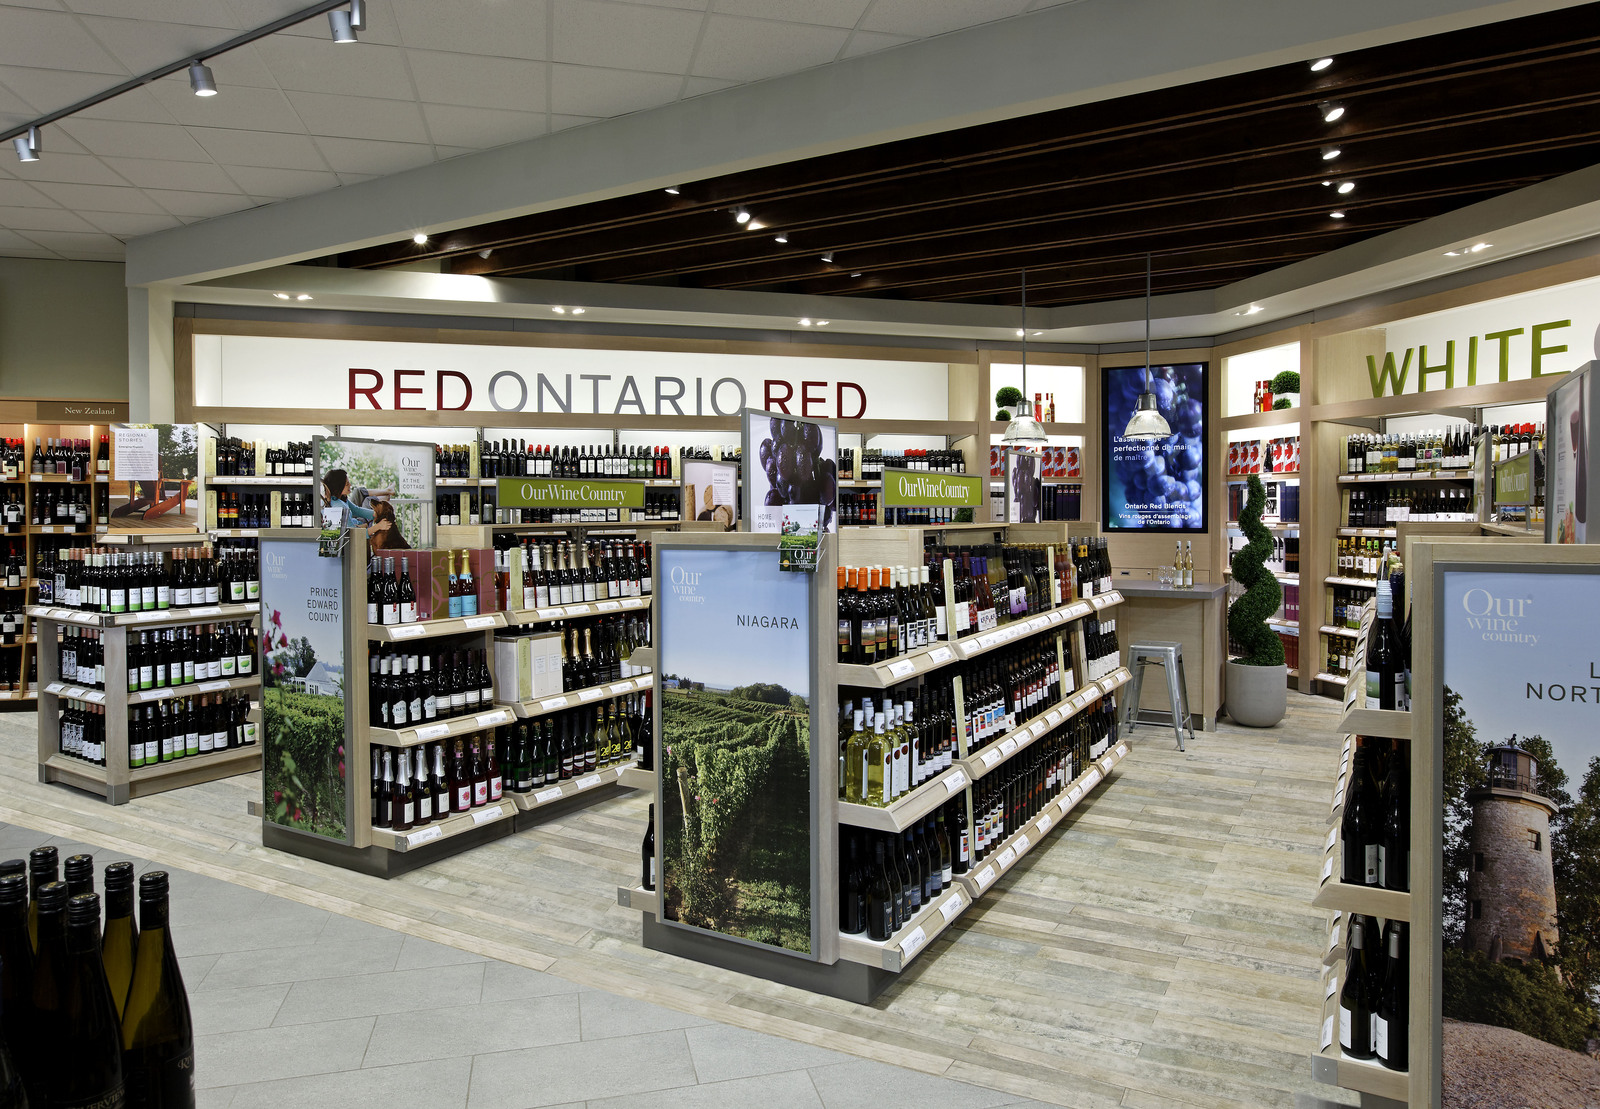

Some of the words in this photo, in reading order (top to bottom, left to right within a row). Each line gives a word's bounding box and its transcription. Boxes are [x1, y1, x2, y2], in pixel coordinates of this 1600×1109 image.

[1366, 319, 1571, 398] WHITE
[349, 368, 473, 411] RED
[488, 370, 747, 417] ONTARIO
[764, 379, 867, 419] RED
[84, 407, 115, 415] Zealand
[1113, 444, 1160, 453] perfectionné
[401, 456, 420, 467] Our
[266, 551, 286, 567] Our
[671, 566, 702, 586] Our
[310, 587, 338, 598] PRINCE
[672, 585, 696, 595] wine
[307, 599, 339, 611] EDWARD
[679, 595, 705, 605] country
[1463, 588, 1532, 617] Our
[308, 612, 339, 623] COUNTY
[737, 614, 799, 630] NIAGARA
[1466, 617, 1519, 632] wine
[1482, 632, 1541, 647] country
[1526, 682, 1600, 704] NORT
